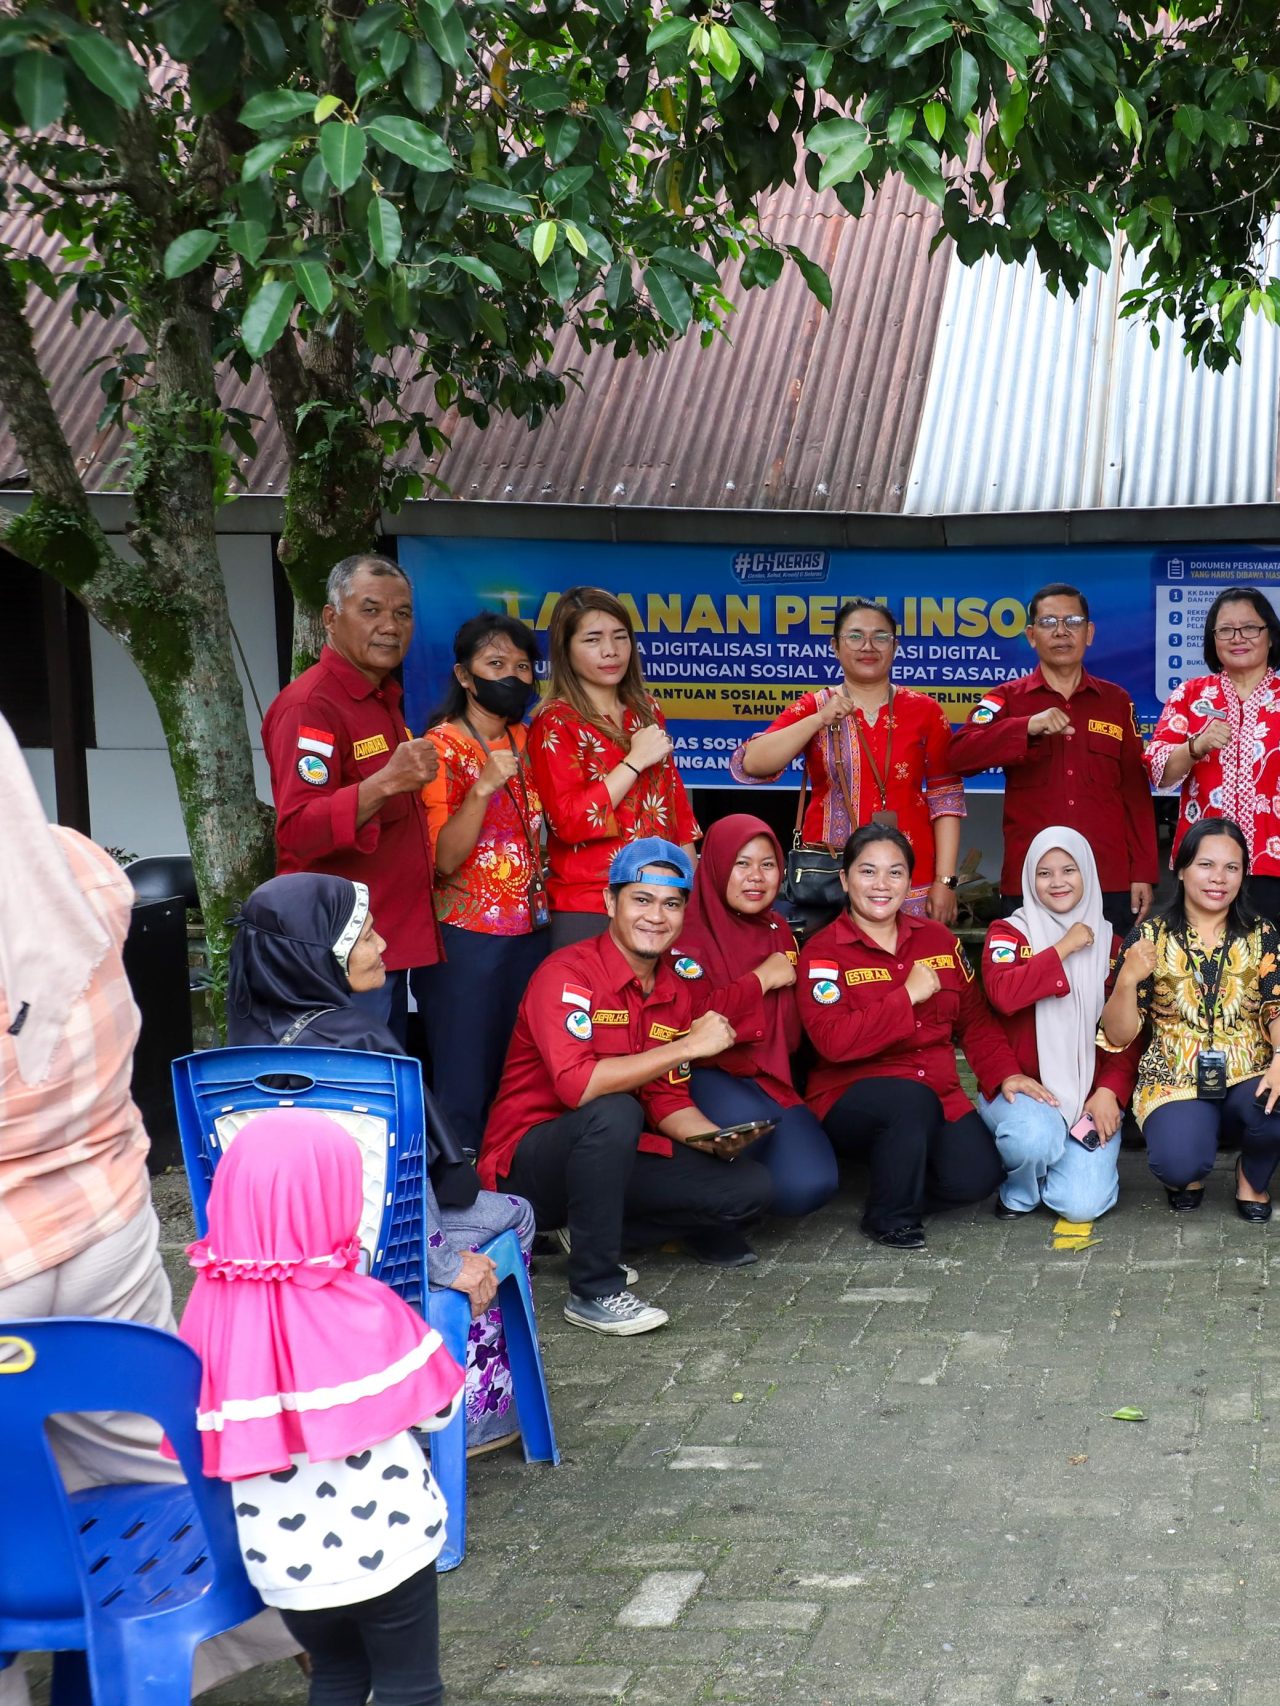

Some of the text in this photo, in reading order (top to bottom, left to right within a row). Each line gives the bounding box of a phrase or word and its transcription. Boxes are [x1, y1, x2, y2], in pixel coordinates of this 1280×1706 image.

[1190, 561, 1230, 569] DOKUMEN
[1190, 570, 1210, 578] YANG
[1211, 571, 1235, 579] HARUS
[1236, 571, 1264, 579] DIBAWA
[1173, 614, 1178, 622] 2
[1172, 636, 1178, 644] 3
[652, 642, 772, 657] DIGITALISASI
[929, 646, 1000, 660] DIGITAL
[1172, 658, 1178, 666] 4
[751, 664, 818, 678] SOSIAL
[891, 666, 938, 680] EPAT
[942, 667, 1034, 681] SASARAN
[646, 688, 716, 699] ANTUAN
[721, 689, 776, 700] SOSIAL
[849, 970, 874, 982] ESTER
